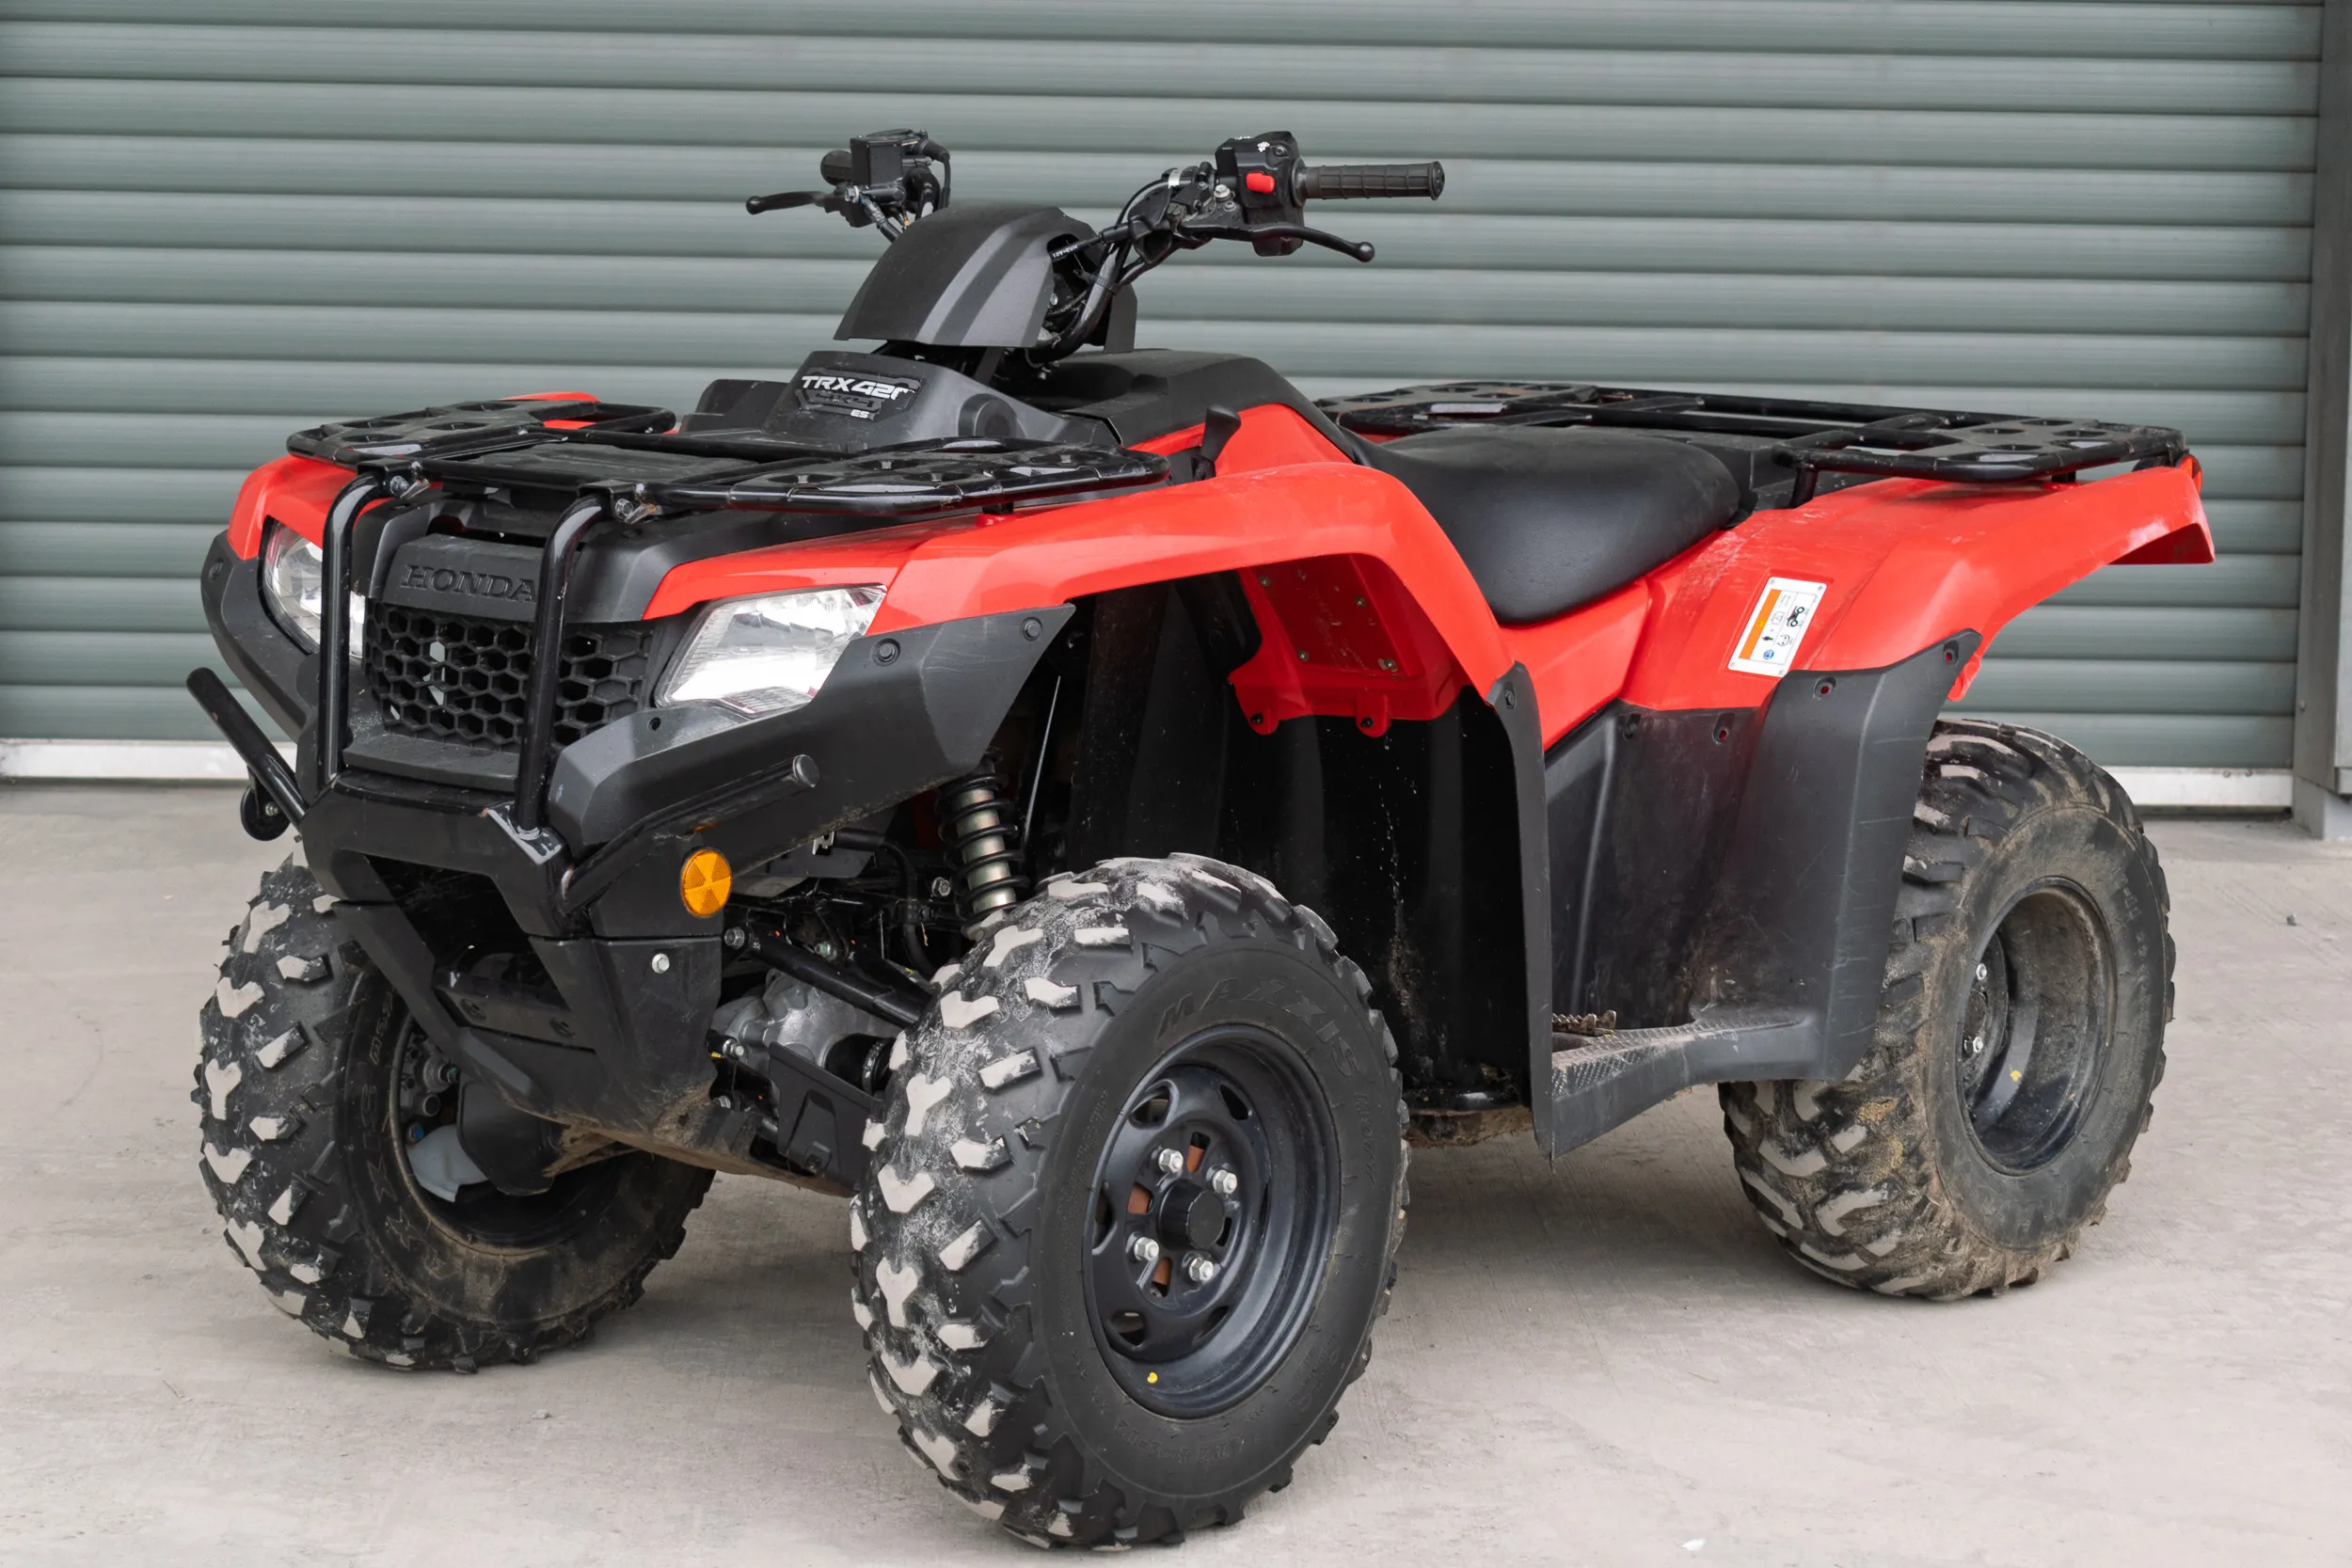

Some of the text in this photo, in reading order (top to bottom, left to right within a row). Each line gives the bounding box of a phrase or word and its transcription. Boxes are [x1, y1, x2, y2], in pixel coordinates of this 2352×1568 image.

[850, 408, 870, 420] ES
[400, 564, 537, 604] HONDA
[1154, 976, 1359, 1077] MAXXIS
